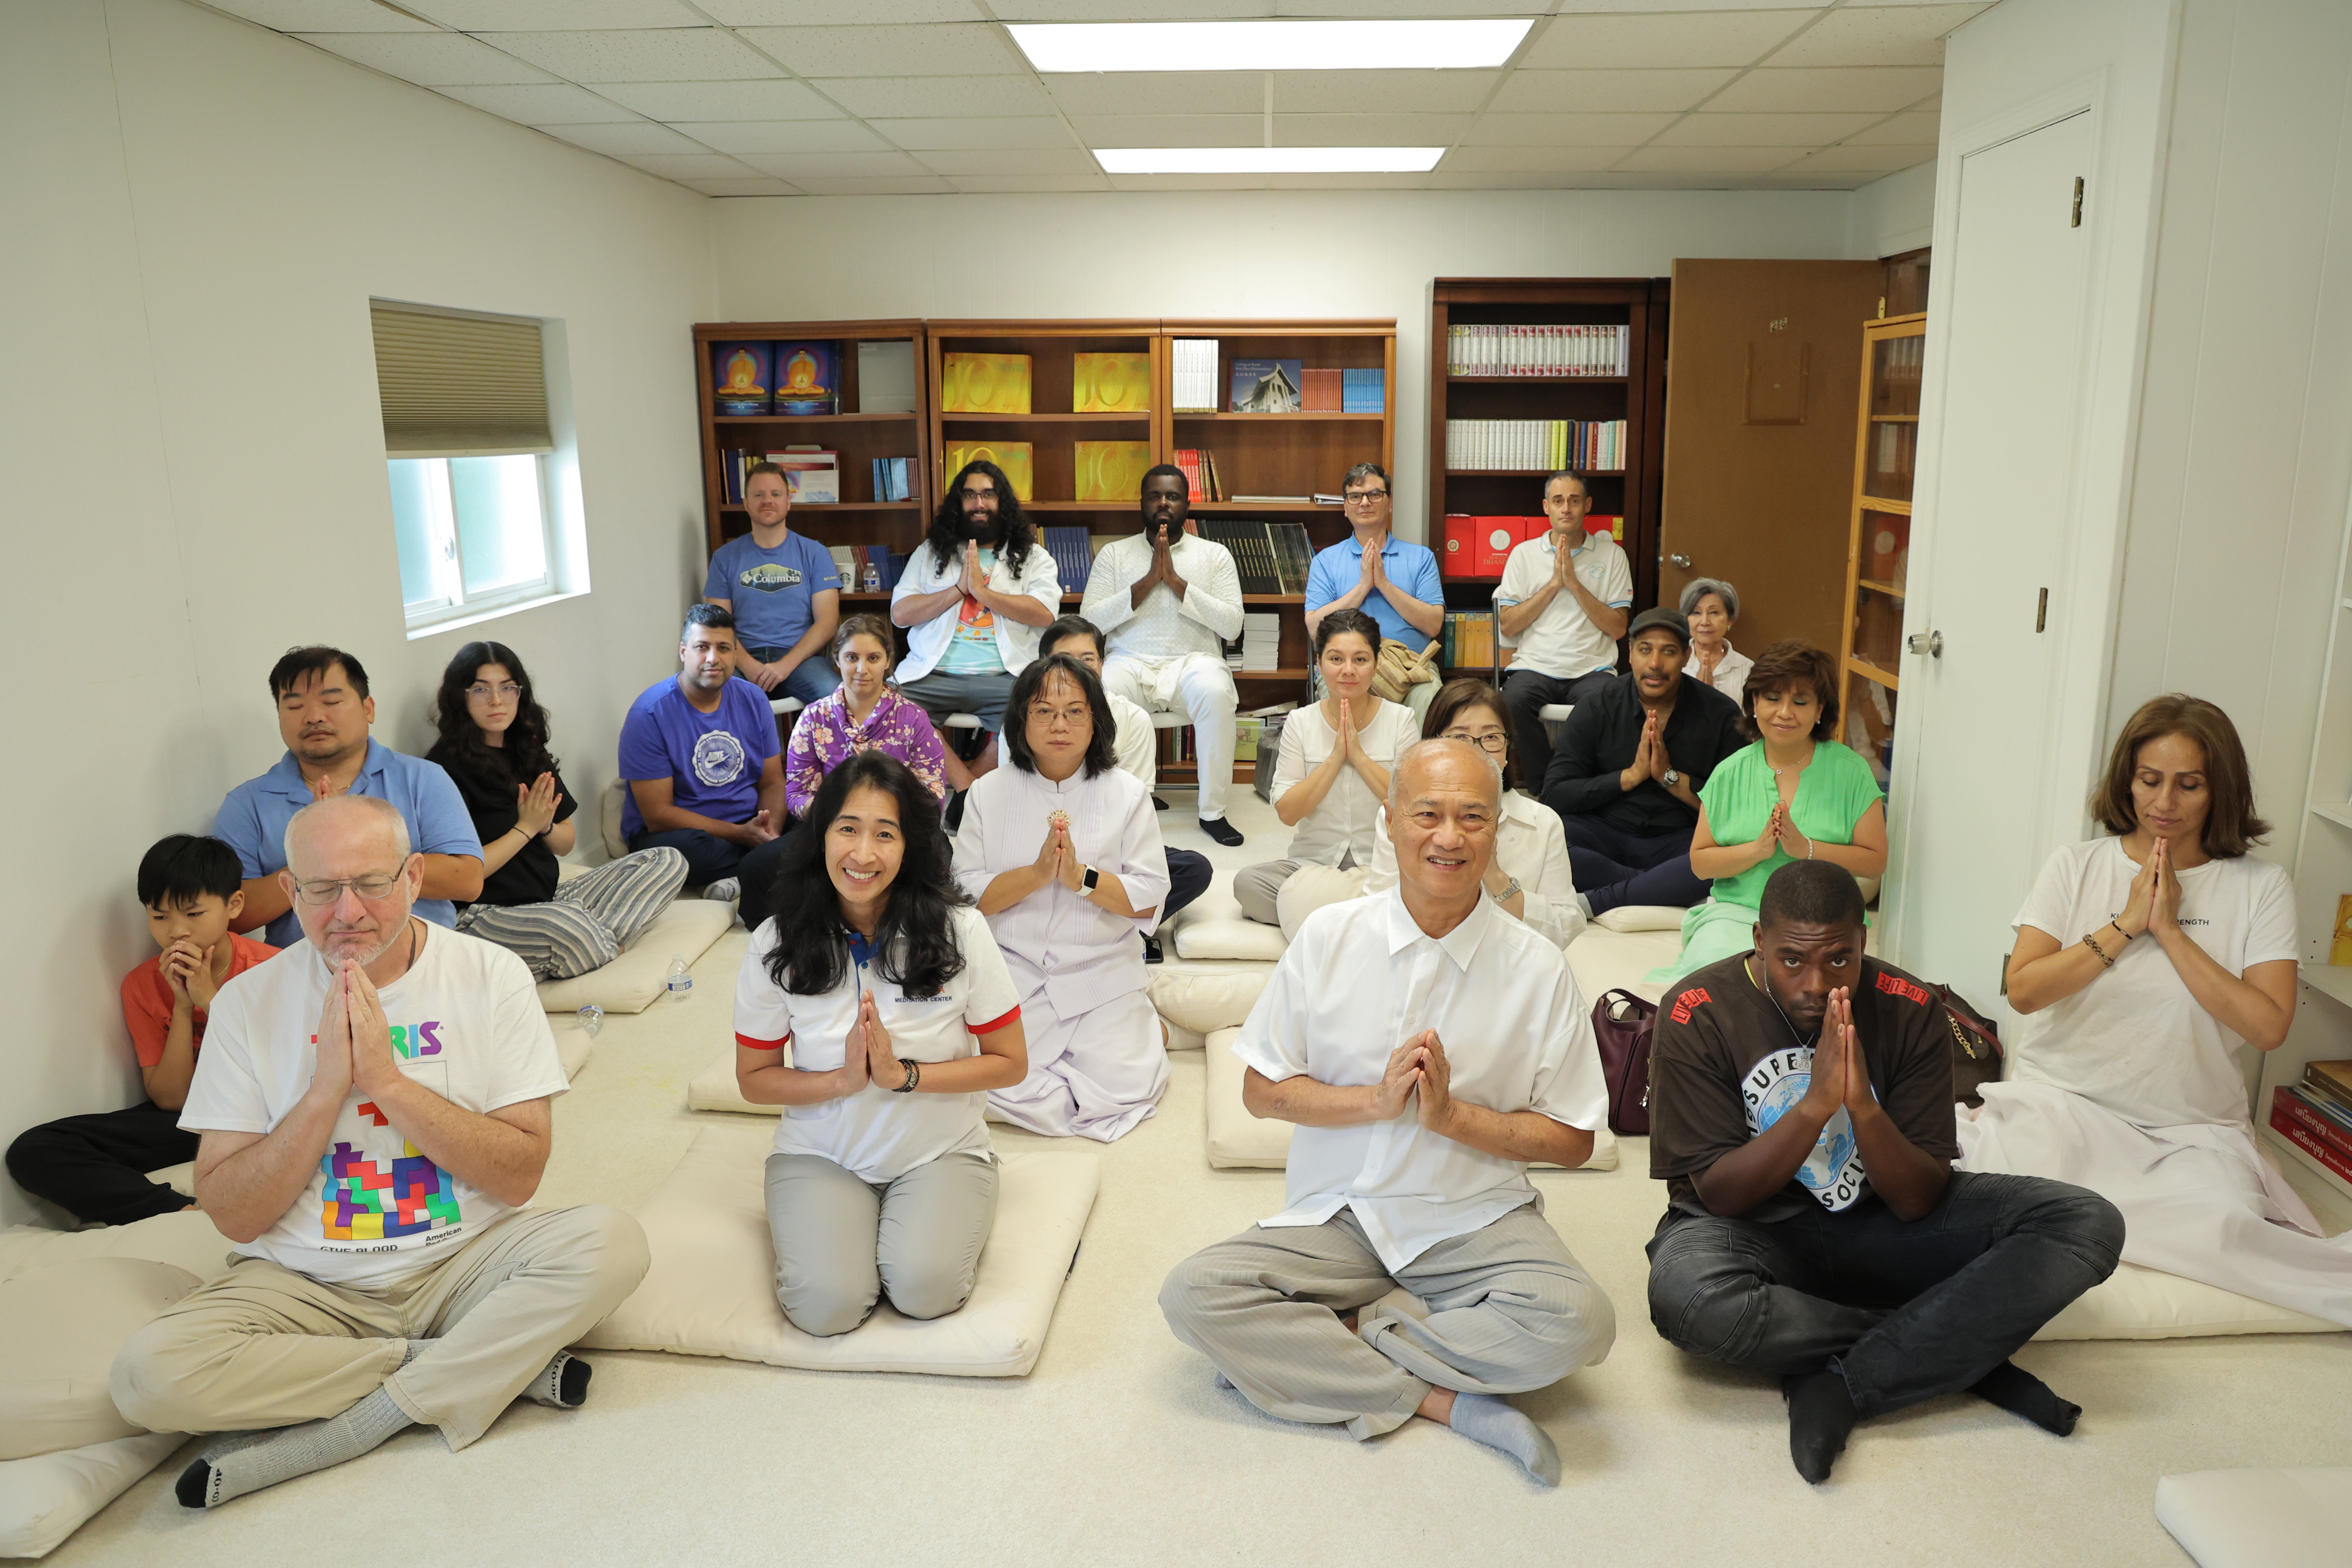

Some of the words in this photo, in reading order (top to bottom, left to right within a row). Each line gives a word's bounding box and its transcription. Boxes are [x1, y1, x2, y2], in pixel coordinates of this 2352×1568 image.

[752, 573, 800, 583] Columbia
[1880, 975, 1901, 992] LIFE
[1902, 983, 1926, 1001] LIVE
[1743, 1052, 1816, 1106] SUPE
[426, 1227, 462, 1242] American
